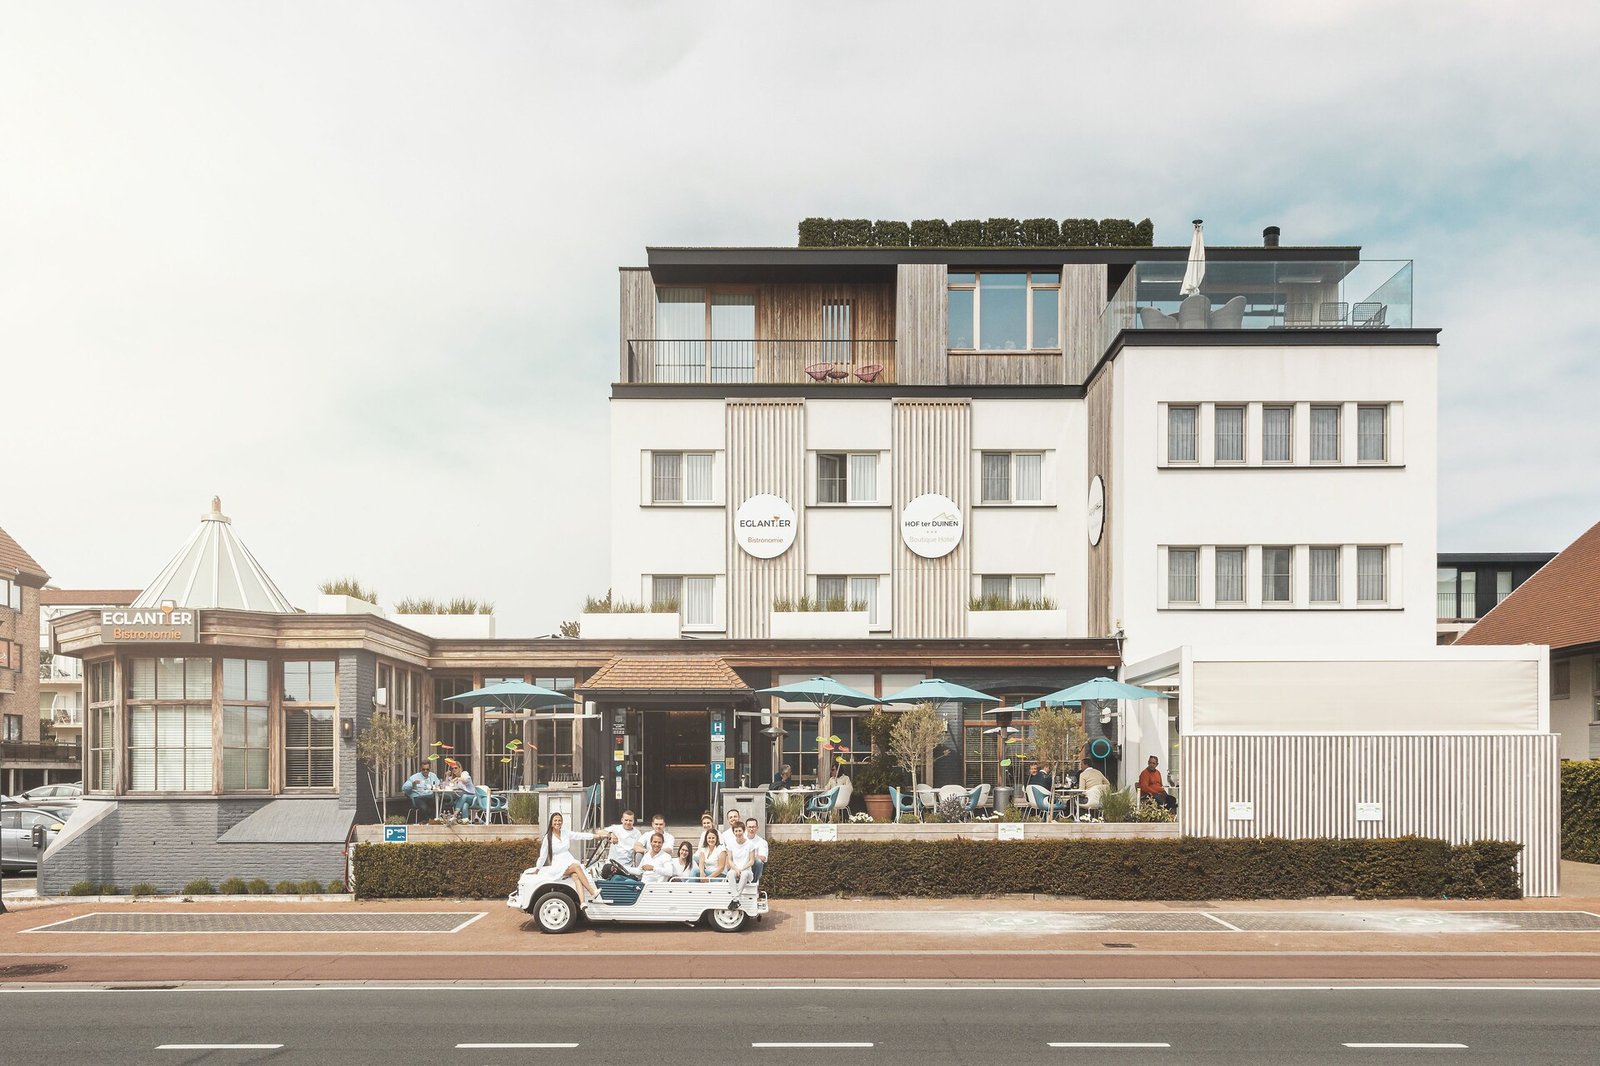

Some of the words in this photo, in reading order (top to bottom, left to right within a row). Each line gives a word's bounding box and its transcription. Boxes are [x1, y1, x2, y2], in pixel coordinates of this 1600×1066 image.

[740, 518, 791, 528] EGLANTIER
[747, 536, 784, 544] Bistronomie
[102, 607, 192, 625] EGLANTIER
[112, 628, 182, 640] Bistronomie
[714, 722, 722, 732] H
[386, 829, 394, 839] P
